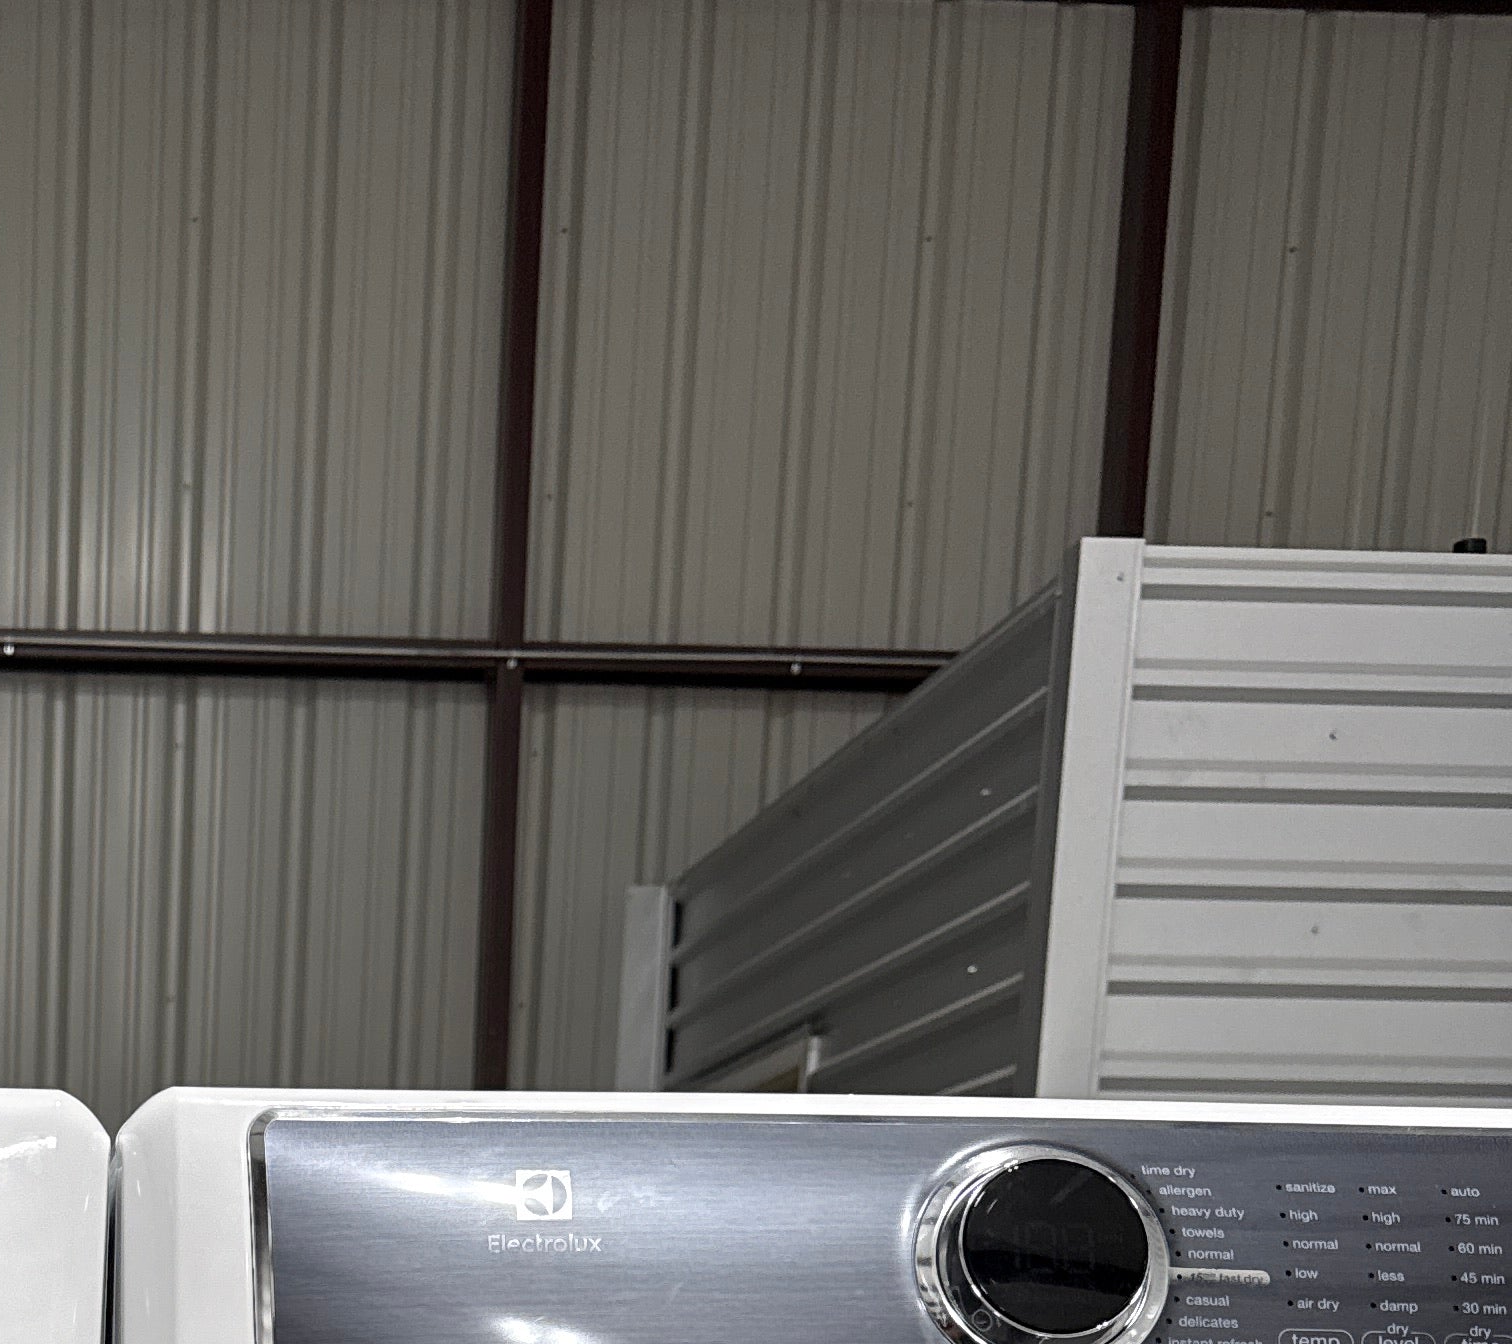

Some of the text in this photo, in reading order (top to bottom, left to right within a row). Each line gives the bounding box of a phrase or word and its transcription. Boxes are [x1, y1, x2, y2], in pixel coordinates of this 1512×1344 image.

[1141, 1165, 1195, 1178] time dry
[1159, 1185, 1212, 1198] allergen
[1286, 1182, 1336, 1193] sanitize
[1368, 1185, 1397, 1195] max
[1451, 1188, 1480, 1197] auto
[1171, 1205, 1244, 1220] heavy duty
[1289, 1210, 1318, 1222] high
[1372, 1212, 1400, 1225] high
[1455, 1214, 1499, 1226] 75 min
[1182, 1227, 1225, 1239] towels
[488, 1233, 602, 1253] Electrolux
[1293, 1239, 1338, 1250] normal
[1376, 1242, 1421, 1252] normal
[1458, 1242, 1503, 1255] 60 min
[1188, 1249, 1234, 1260] normal
[1295, 1268, 1318, 1279] low
[1378, 1270, 1404, 1281] less
[1460, 1272, 1506, 1285] 45 min
[1186, 1295, 1229, 1307] casual
[1297, 1298, 1340, 1312] air dry
[1380, 1300, 1418, 1314] damp
[1462, 1302, 1507, 1315] 30 min
[1179, 1316, 1238, 1328] delicates
[1387, 1323, 1409, 1337] dry
[1469, 1325, 1492, 1340] dry
